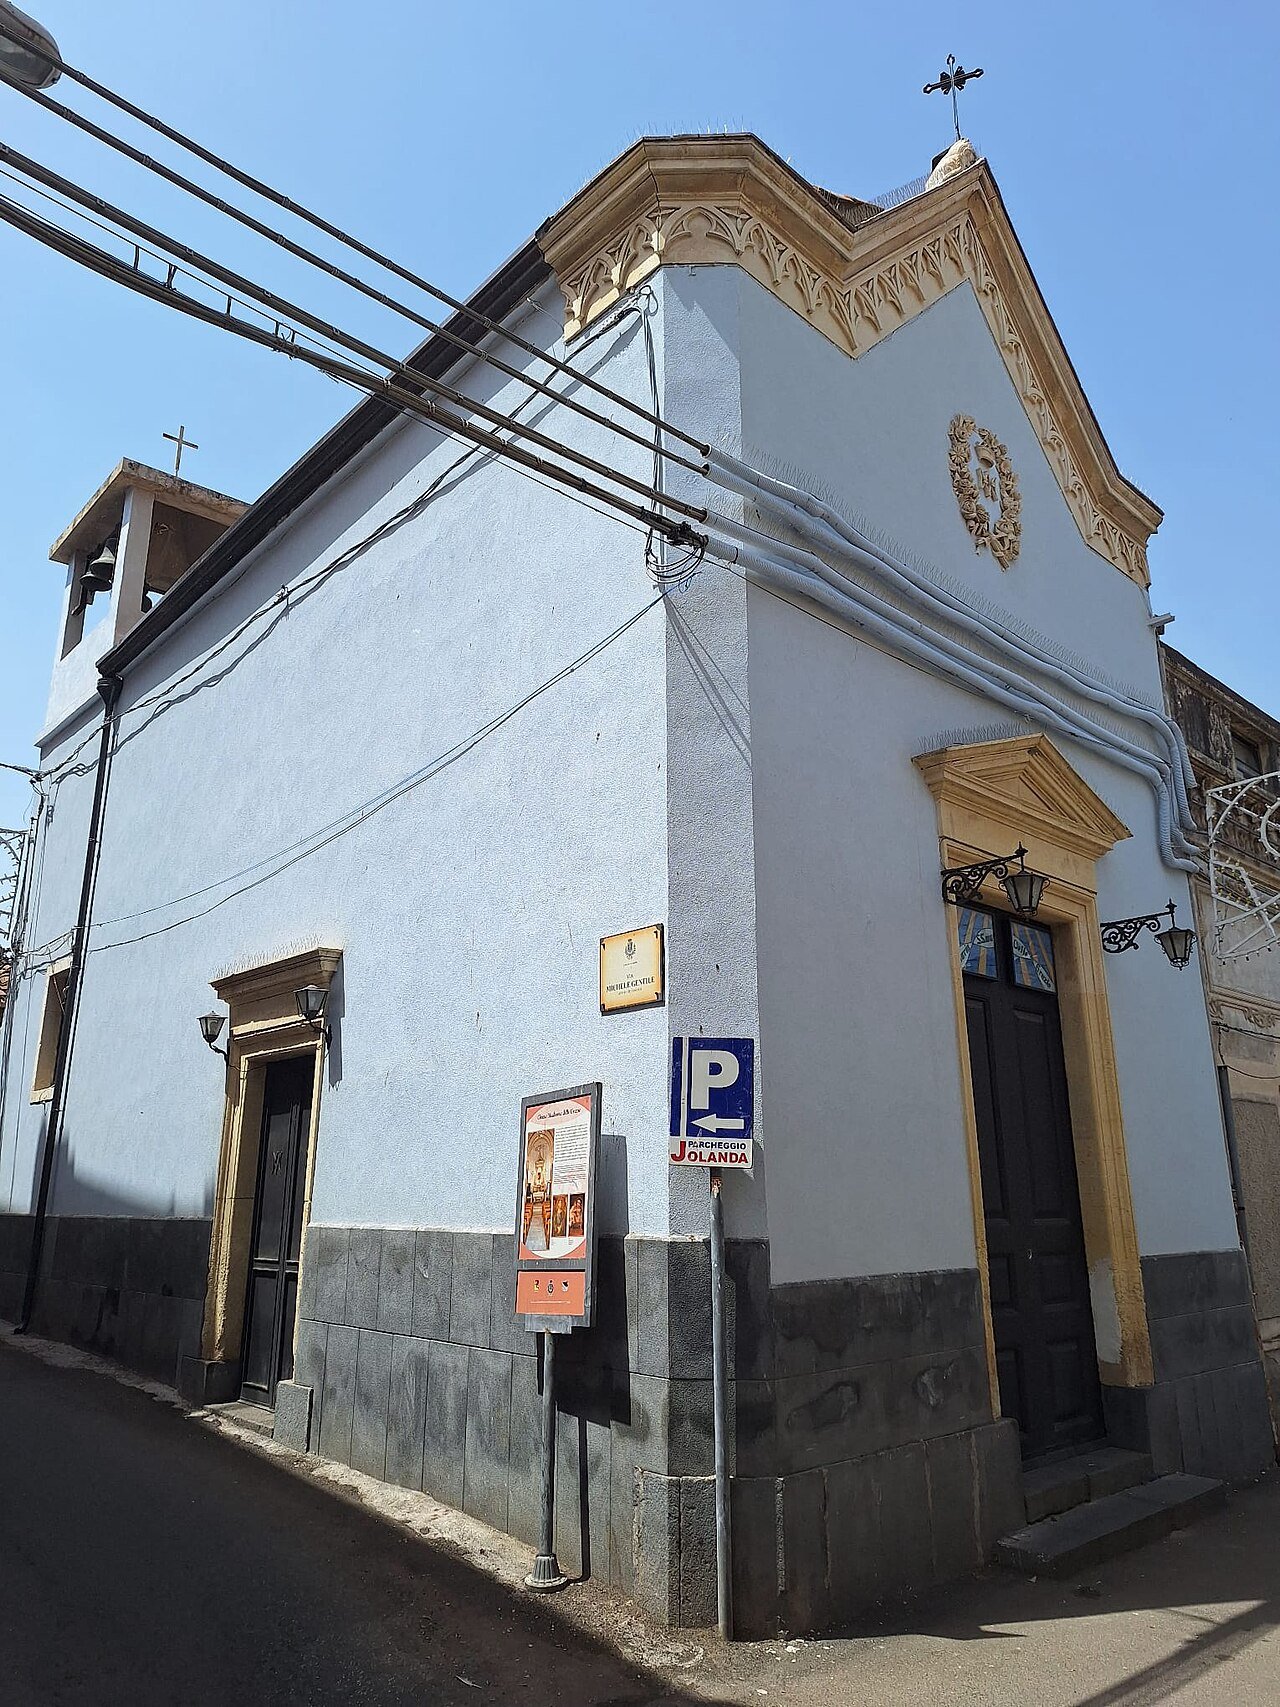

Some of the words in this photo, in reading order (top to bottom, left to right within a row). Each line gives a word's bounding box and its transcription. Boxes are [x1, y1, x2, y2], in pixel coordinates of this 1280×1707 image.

[630, 976, 656, 988] GENTILE
[690, 1049, 740, 1110] P
[670, 1140, 749, 1164] JOLANDA
[688, 1140, 747, 1150] PARCHEGGIO
